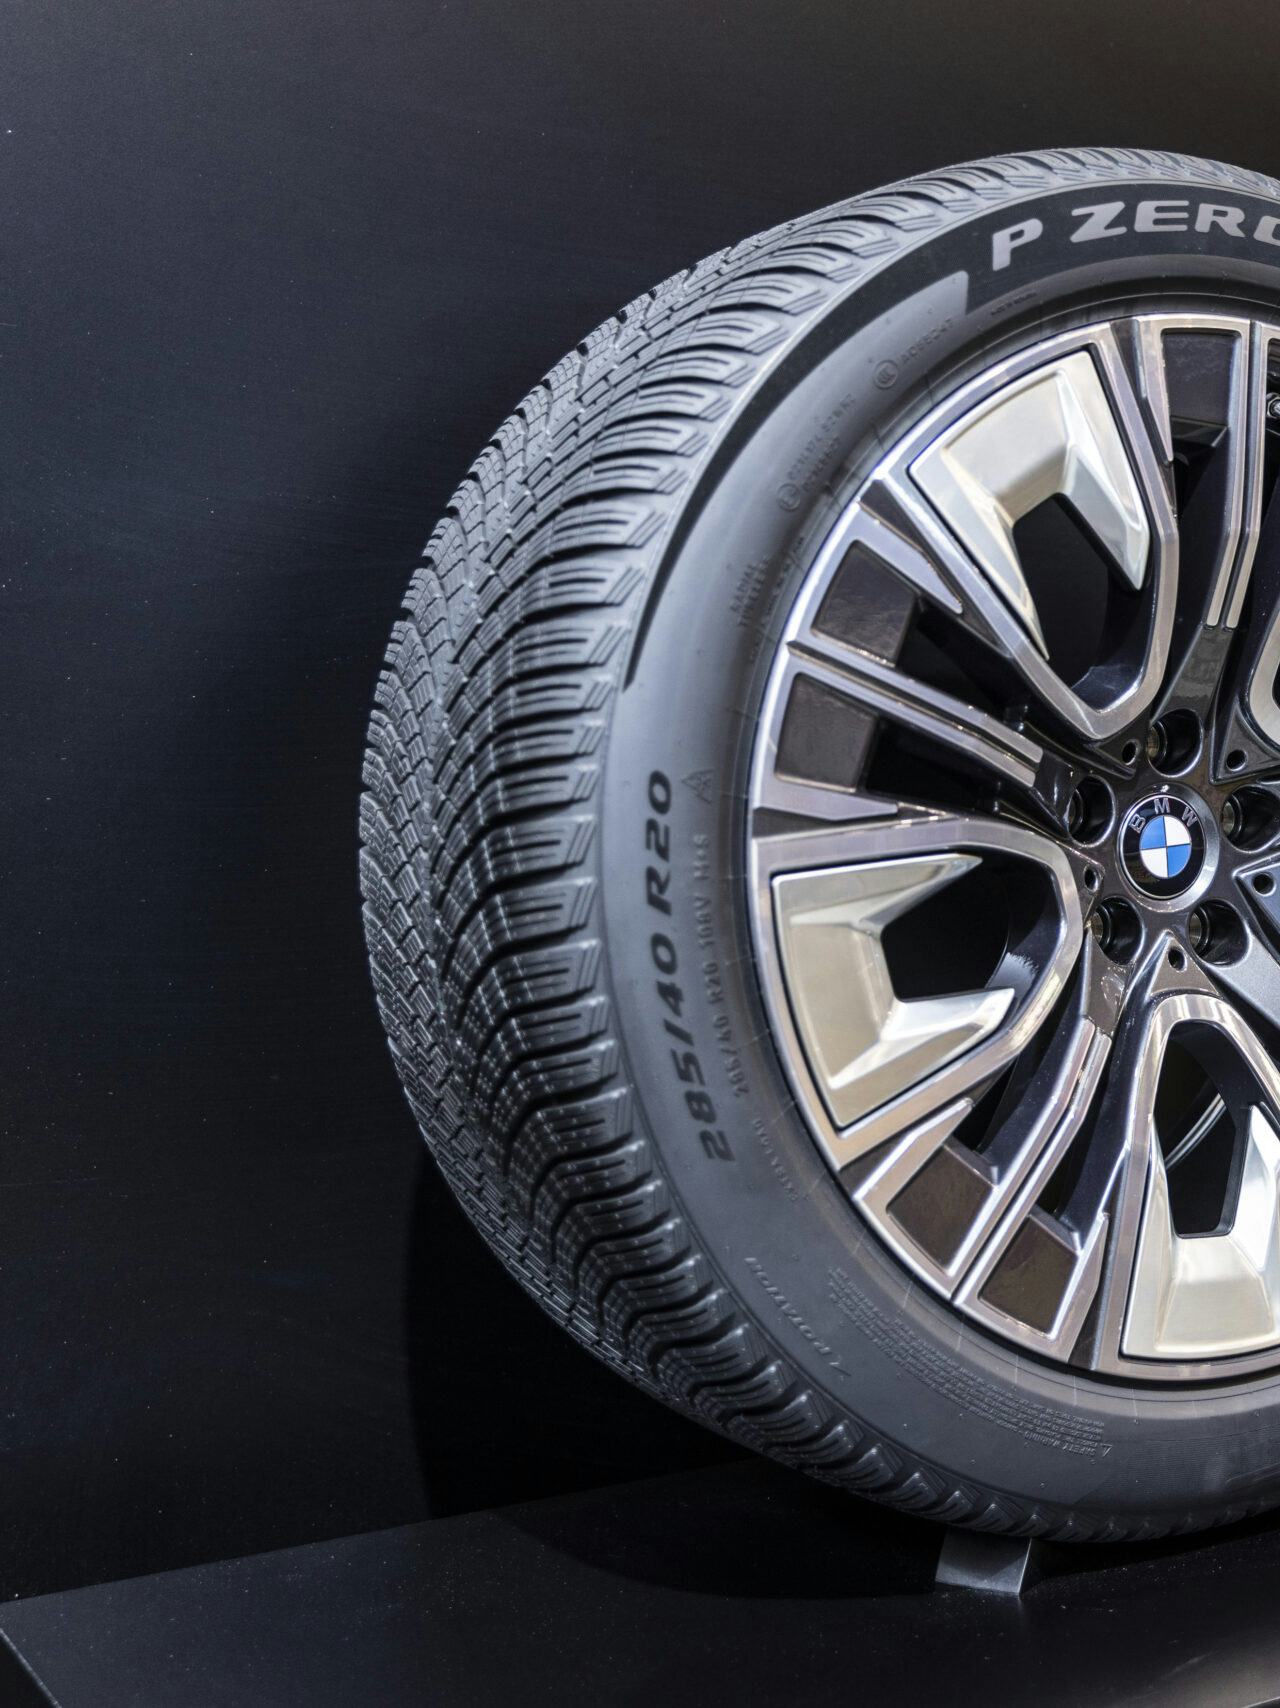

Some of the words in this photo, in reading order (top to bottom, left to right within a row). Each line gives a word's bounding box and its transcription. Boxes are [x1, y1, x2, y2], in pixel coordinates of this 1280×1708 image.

[992, 217, 1044, 271] P
[645, 770, 673, 916] R20
[1129, 797, 1199, 834] BMW
[651, 932, 736, 1162] 285/40
